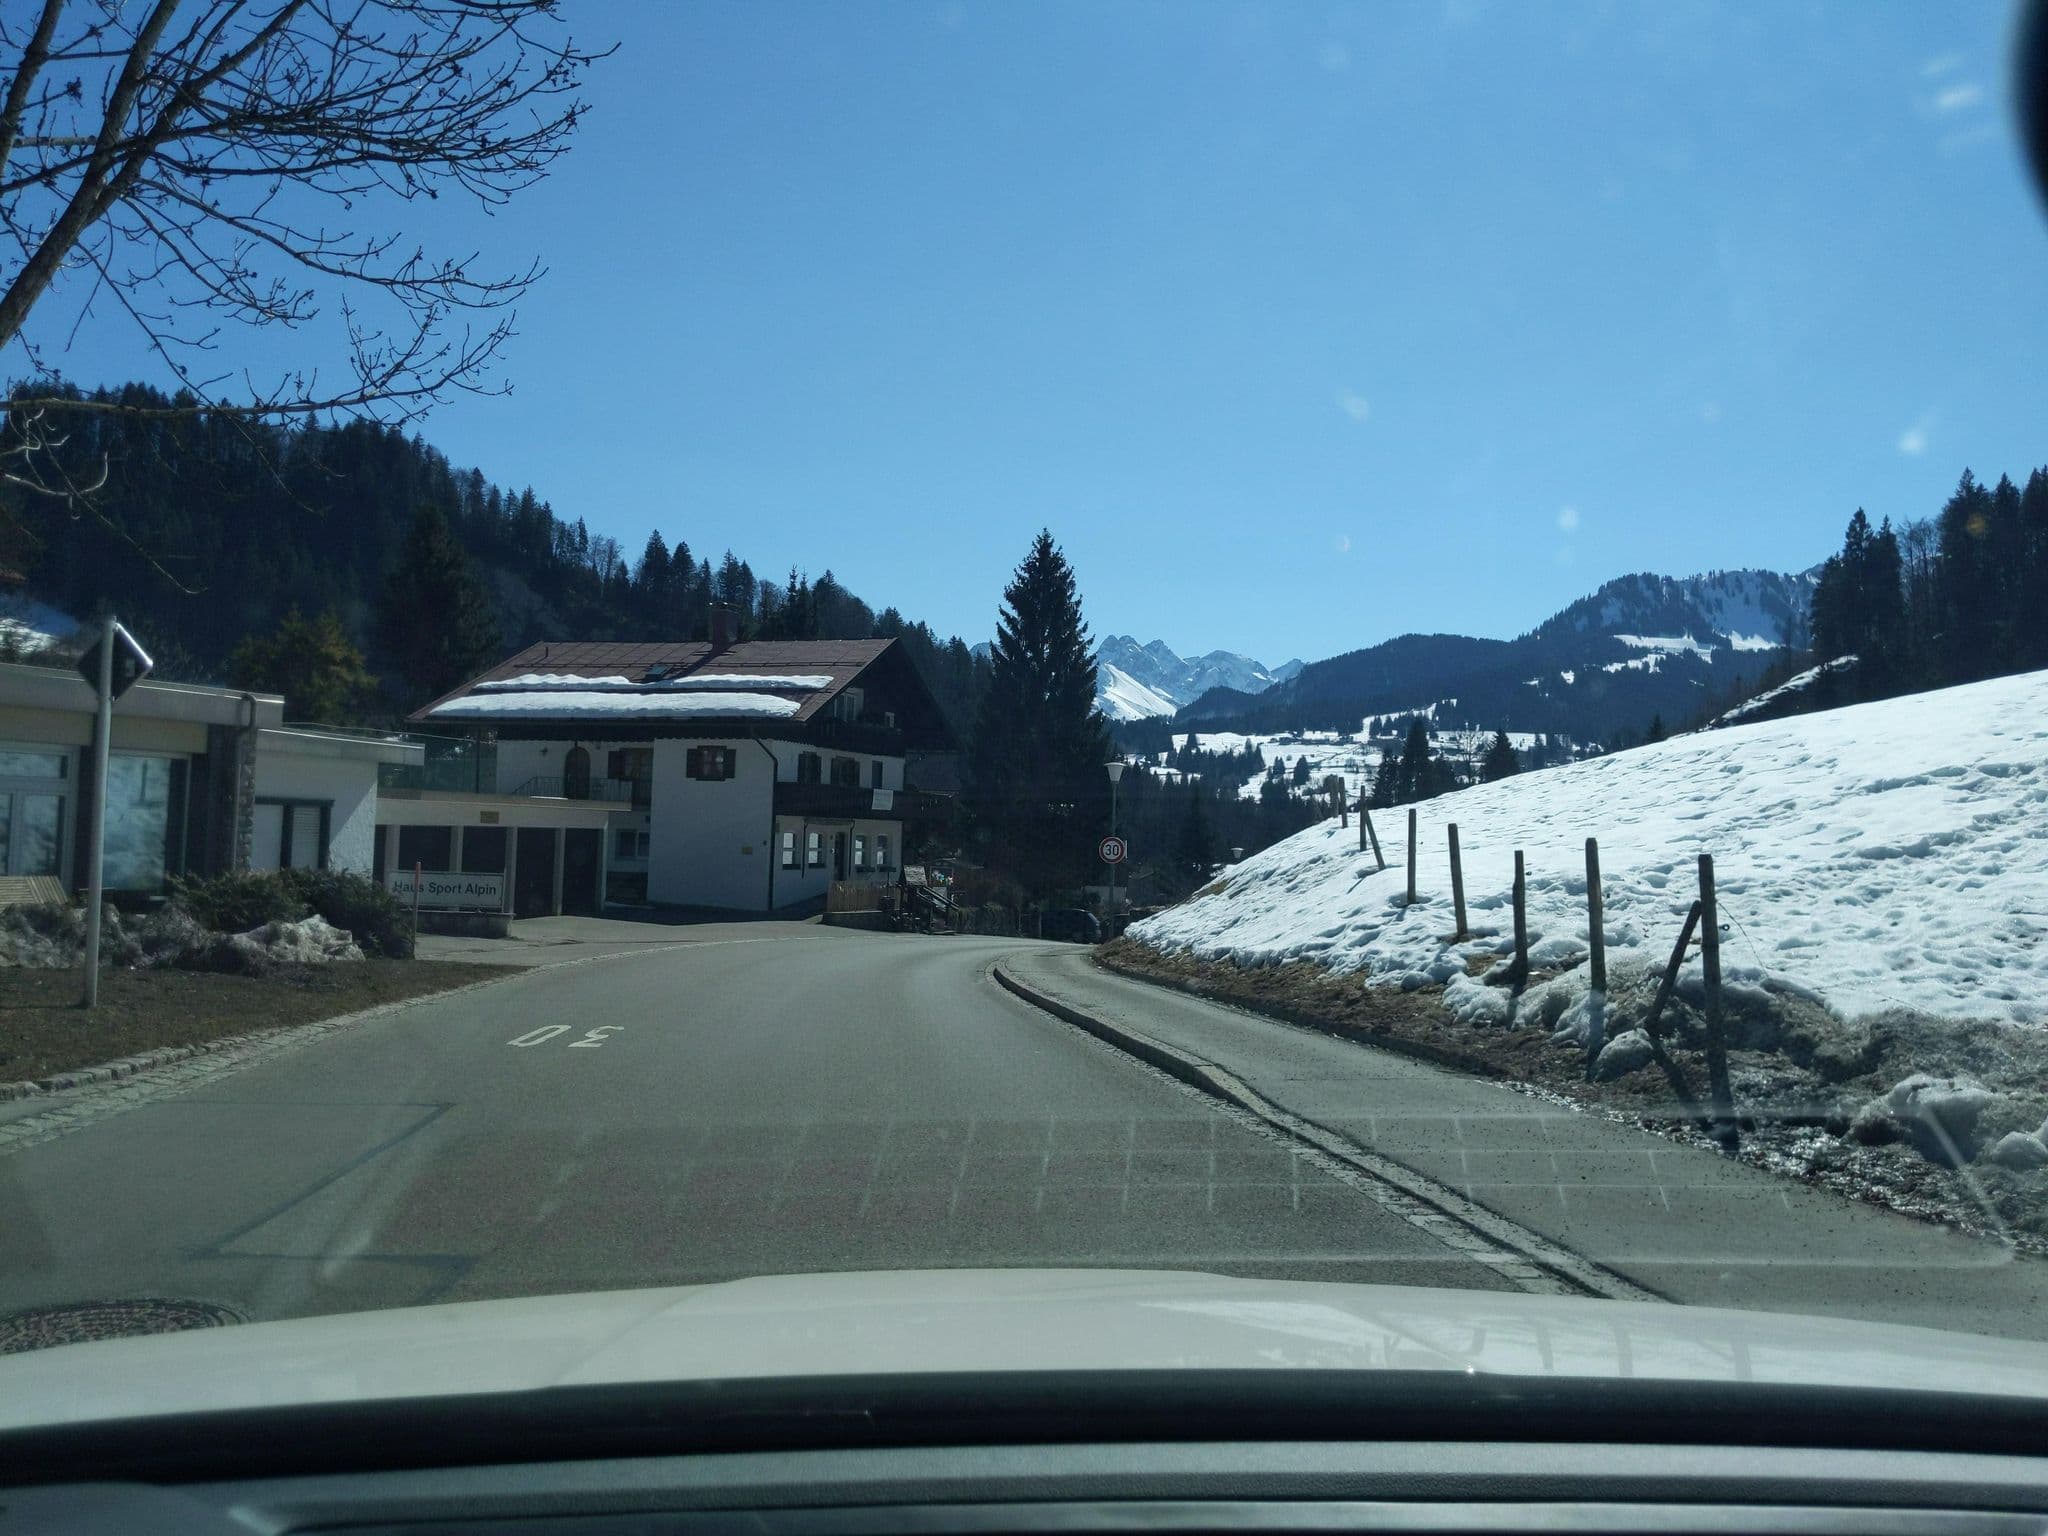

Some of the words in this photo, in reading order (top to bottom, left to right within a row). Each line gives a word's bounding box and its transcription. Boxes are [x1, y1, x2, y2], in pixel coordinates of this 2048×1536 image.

[1104, 844, 1120, 856] 30
[393, 880, 425, 893] Haus
[428, 881, 461, 896] Sport
[464, 883, 497, 896] Alpin
[506, 1024, 625, 1048] 30
